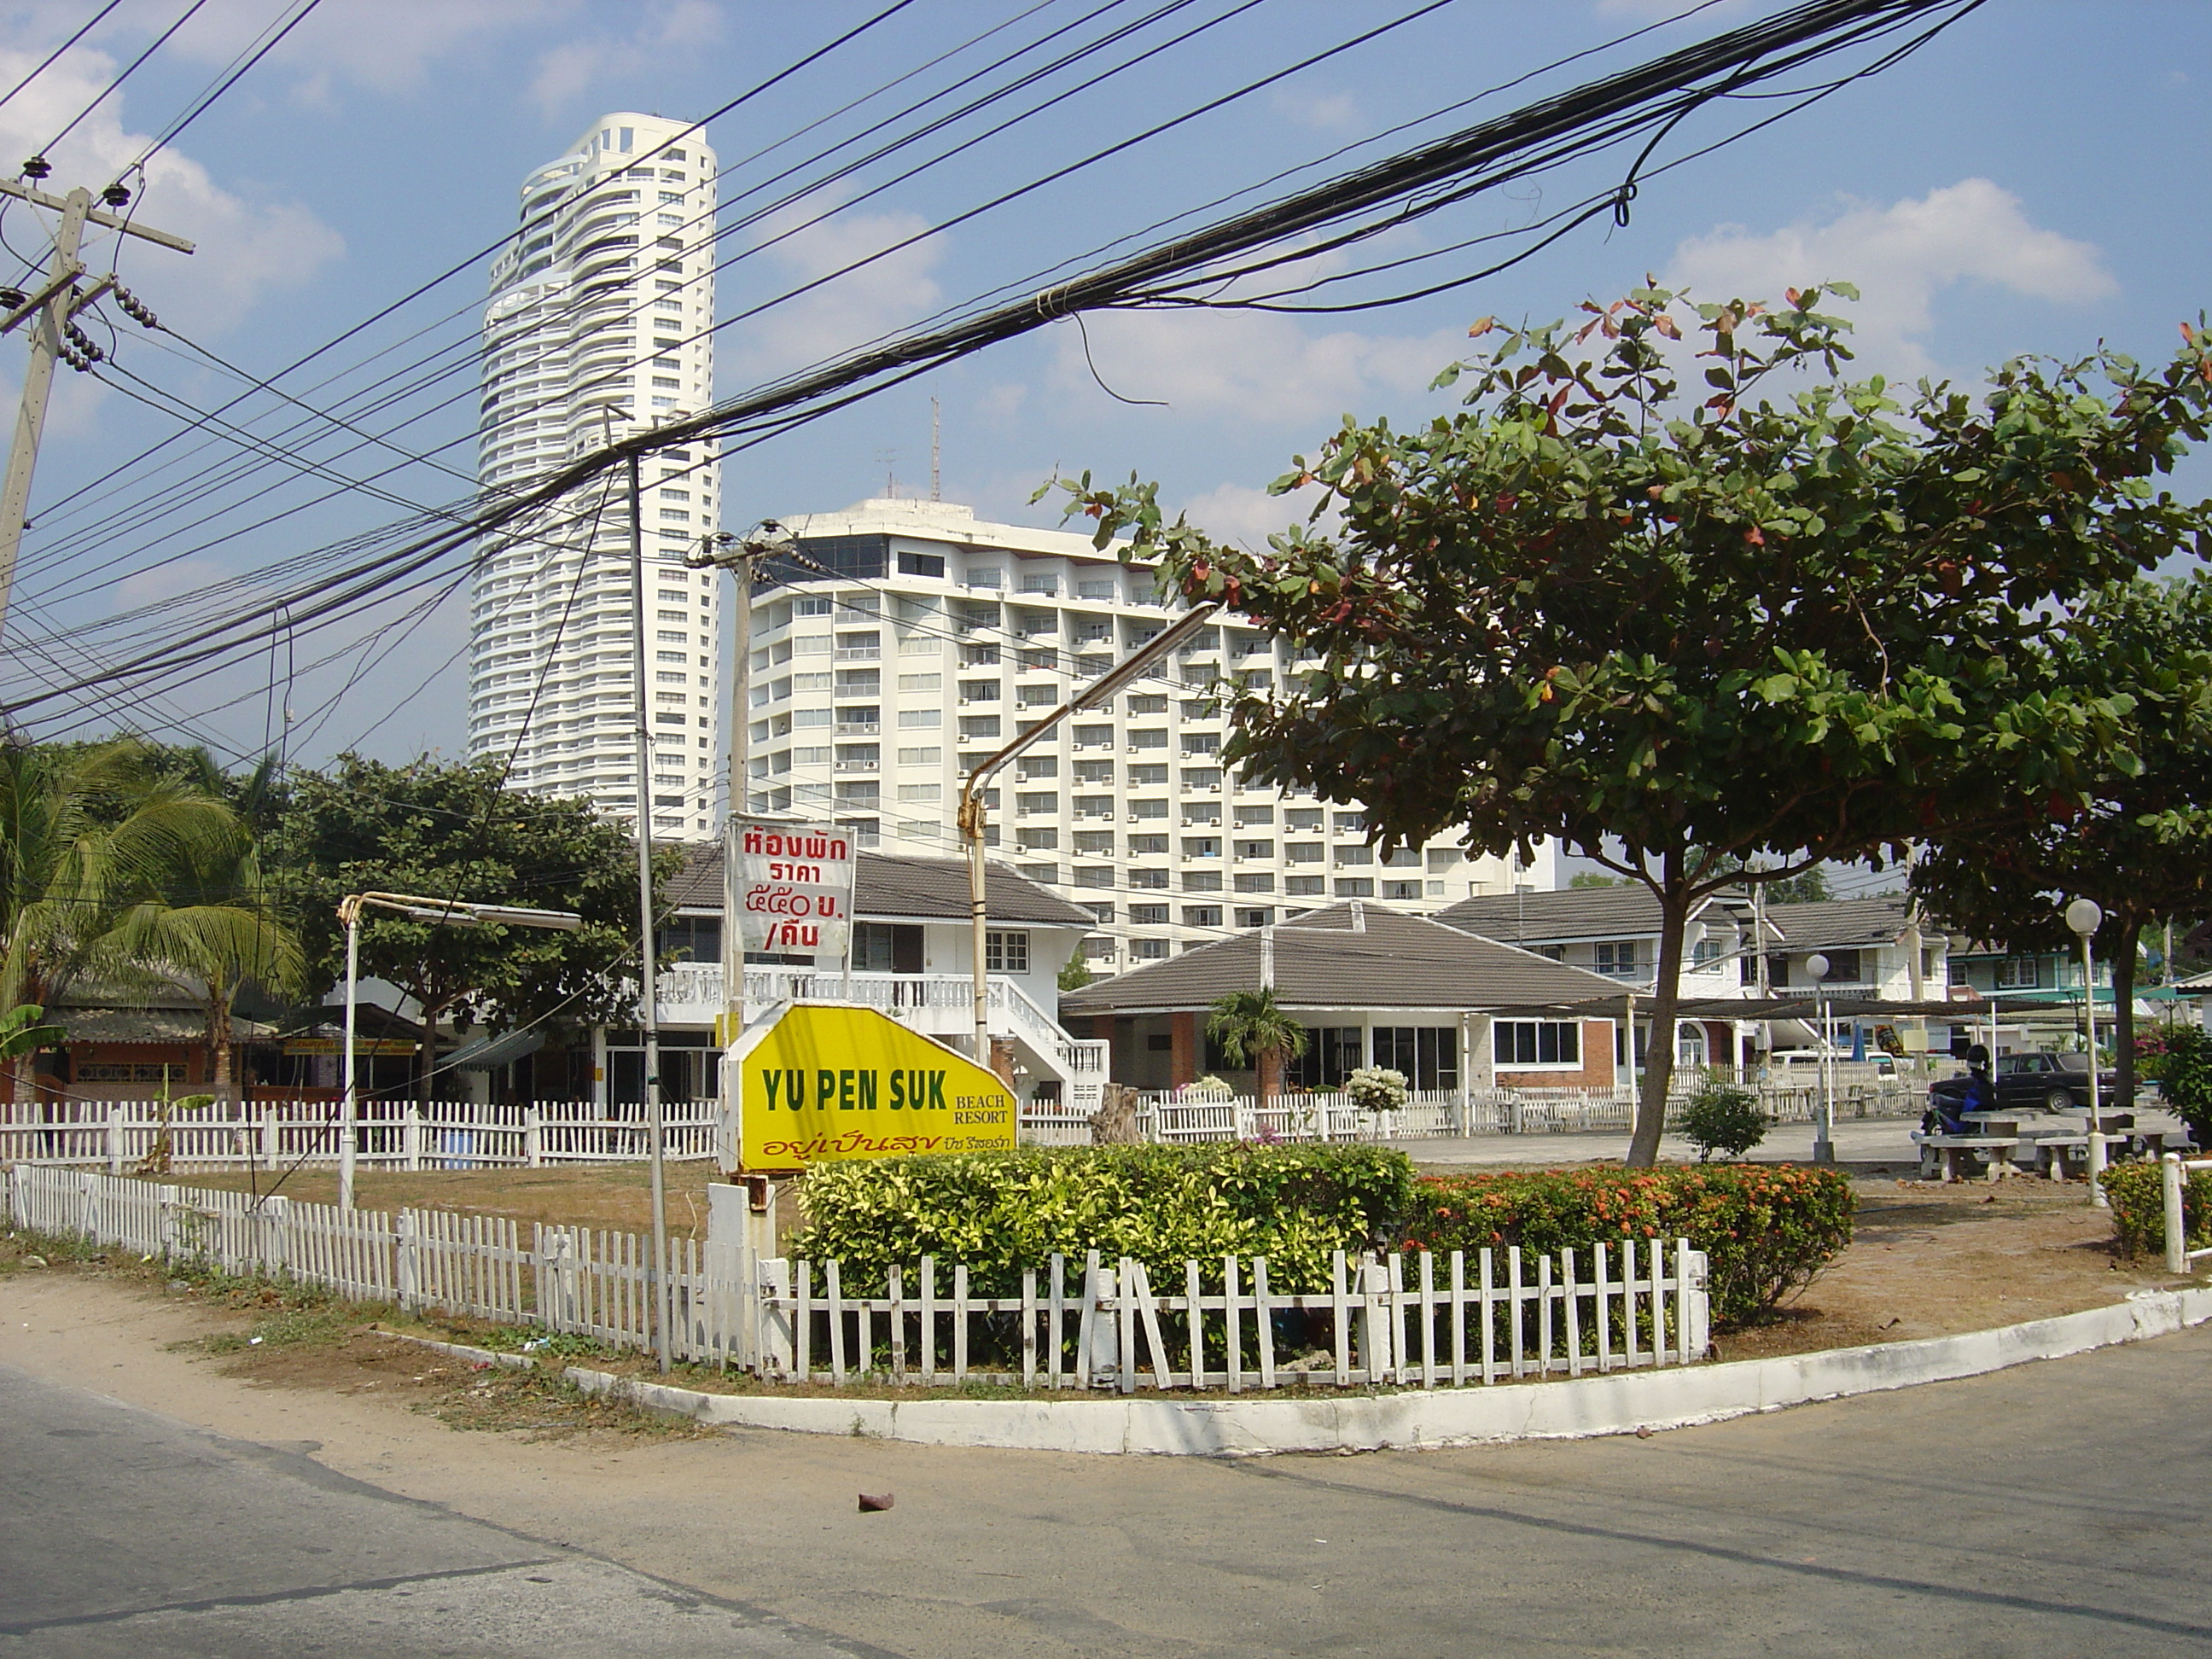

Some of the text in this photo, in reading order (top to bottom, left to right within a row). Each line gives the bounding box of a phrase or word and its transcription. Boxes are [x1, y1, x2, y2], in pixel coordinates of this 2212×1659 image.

[744, 825, 847, 860] ห้องพัก
[770, 863, 820, 883] ราคา
[746, 884, 843, 919] ๕๕๐ บ.
[762, 1069, 947, 1111] YU PEN SUK
[956, 1095, 1005, 1109] BEACH
[954, 1110, 1008, 1125] RESORT
